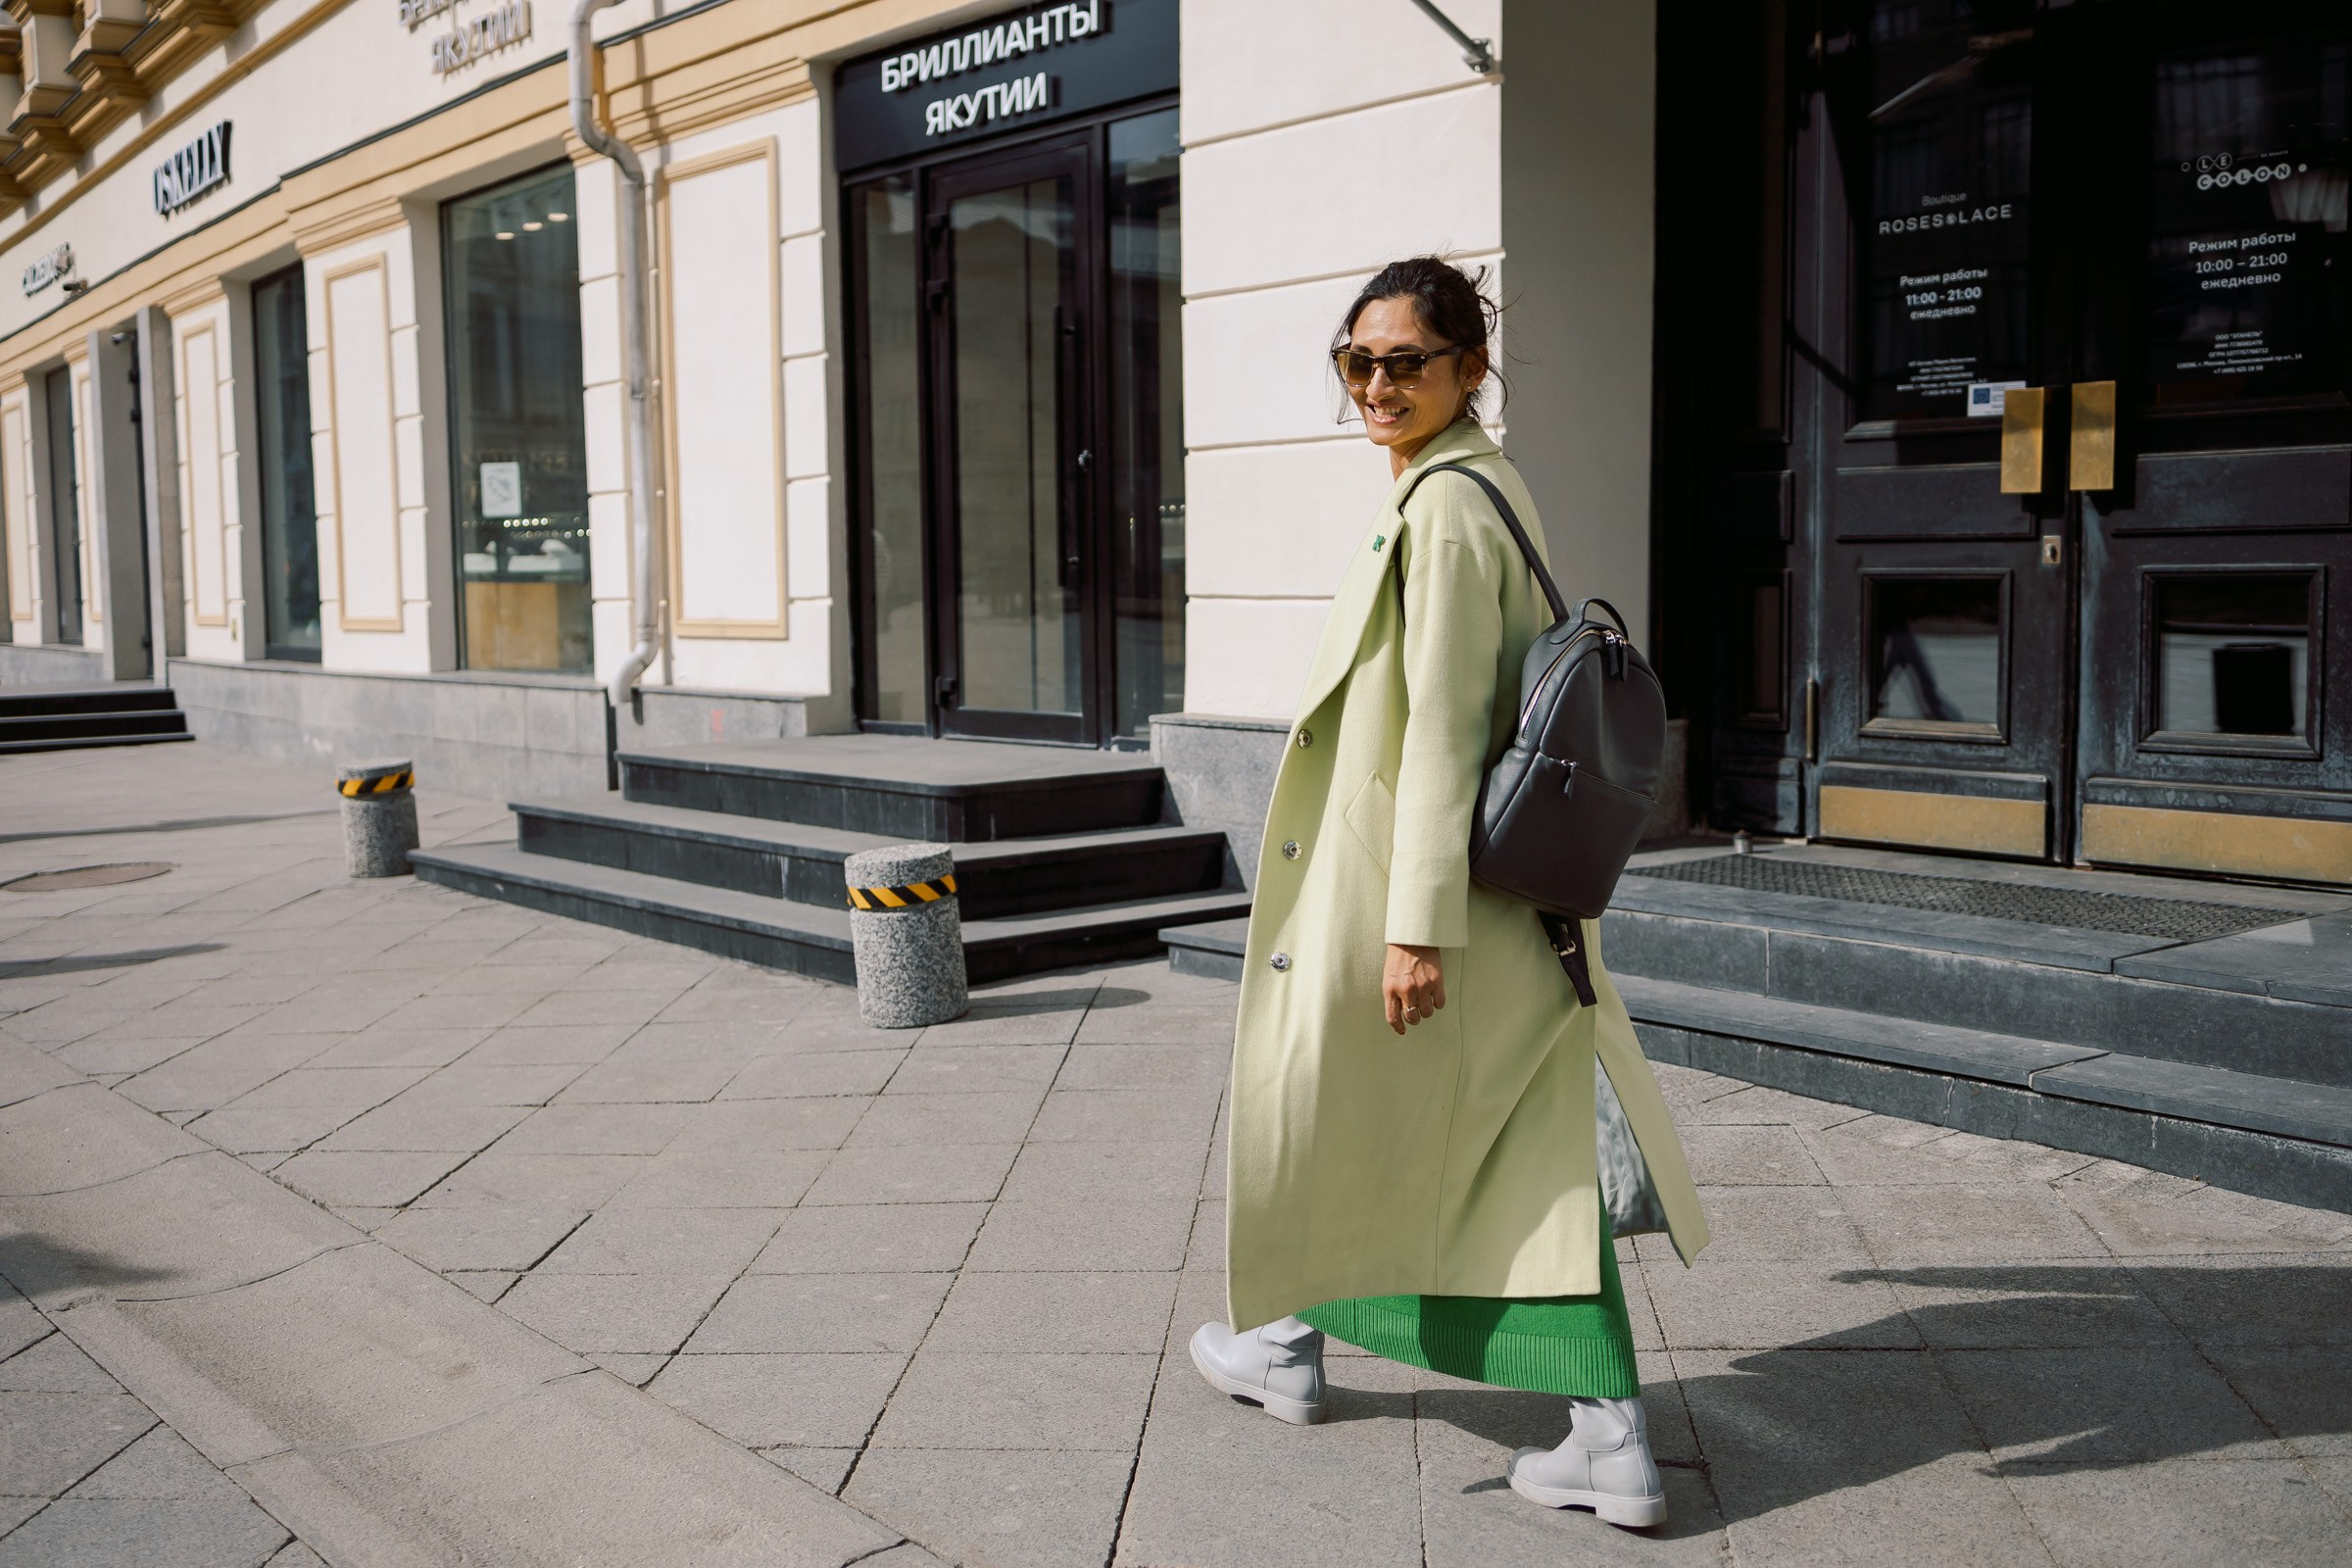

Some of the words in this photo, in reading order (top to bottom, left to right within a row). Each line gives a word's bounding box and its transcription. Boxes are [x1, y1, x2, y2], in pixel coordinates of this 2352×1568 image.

[431, 0, 524, 74] ЯКУТИИ
[881, 0, 1099, 93] БРИЛЛИАНТЫ
[925, 72, 1047, 136] ЯКУТИИ
[154, 120, 225, 214] OSKELLY
[2196, 152, 2232, 173] LE
[2197, 163, 2291, 191] COLON
[1922, 192, 1968, 207] Boutique
[2188, 238, 2238, 254] Режим
[2241, 232, 2297, 250] работы
[2195, 258, 2233, 274] 10:00
[2249, 252, 2288, 269] 21:00
[1899, 274, 1941, 288] Режим
[1942, 268, 1988, 284] работы
[2201, 272, 2281, 290] ежедневно
[1905, 291, 1937, 307] 11:00
[1946, 286, 1983, 302] 21:00
[1910, 304, 1977, 320] ежедневно
